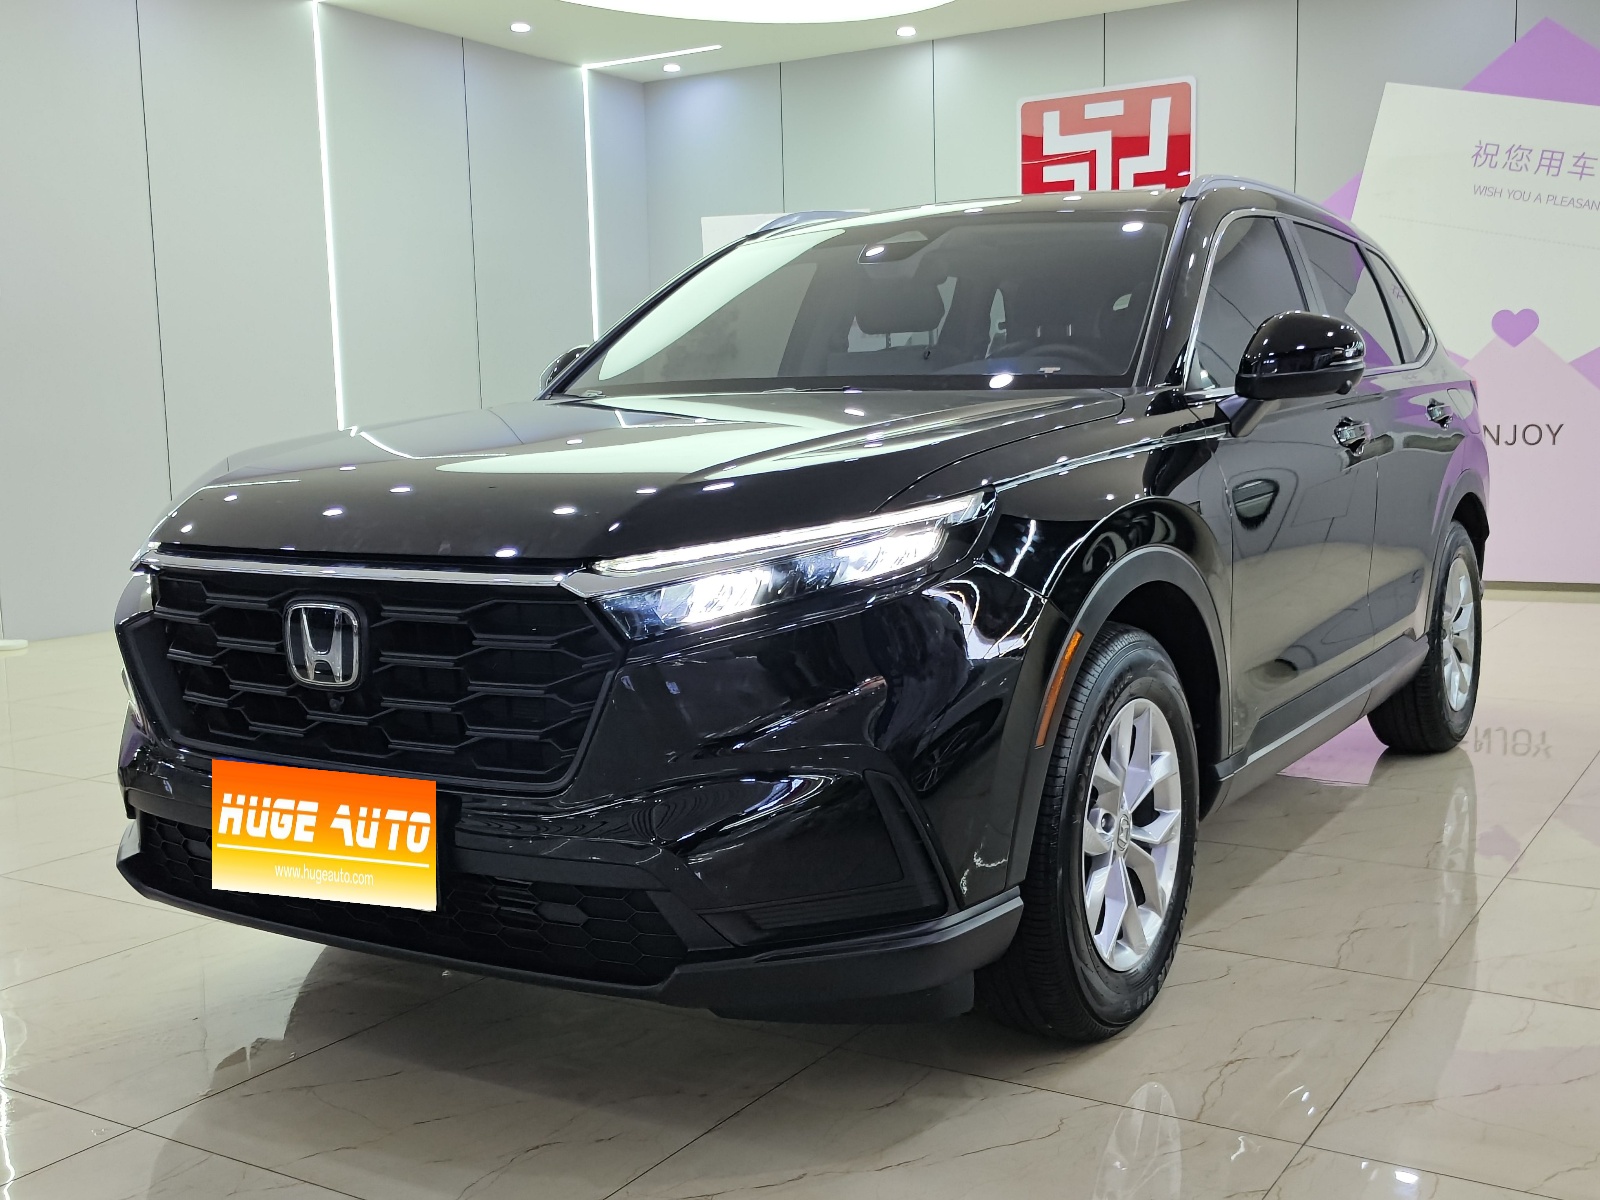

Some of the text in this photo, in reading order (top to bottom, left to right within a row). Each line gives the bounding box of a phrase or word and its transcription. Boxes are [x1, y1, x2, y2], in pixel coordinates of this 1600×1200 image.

[1471, 140, 1599, 181] 祝您用车
[1473, 184, 1503, 198] WISH
[1507, 189, 1532, 202] YOU
[1533, 193, 1542, 204] A
